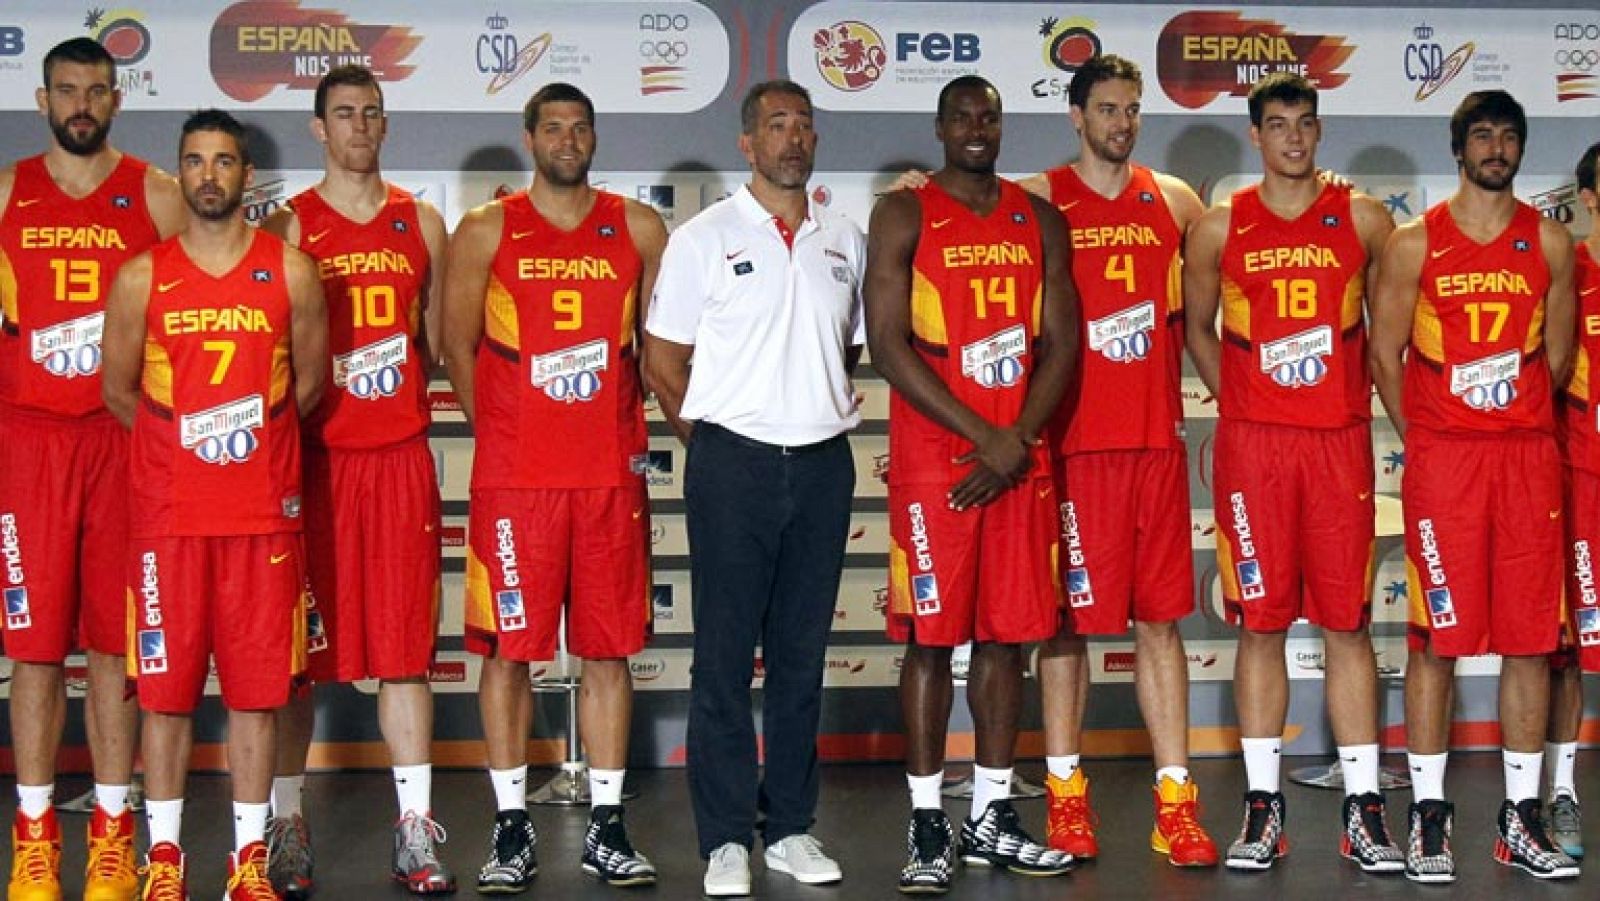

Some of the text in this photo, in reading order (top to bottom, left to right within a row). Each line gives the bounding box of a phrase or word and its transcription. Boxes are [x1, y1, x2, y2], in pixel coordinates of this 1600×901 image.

[237, 23, 361, 53] ESPAÑA
[639, 14, 689, 31] ADO
[295, 55, 330, 76] NOS
[476, 35, 518, 74] CSD
[1182, 33, 1297, 62] ESPAÑA
[1404, 44, 1443, 81] CSD
[1237, 64, 1270, 84] NOS
[22, 224, 126, 250] ESPAÑA
[943, 241, 1034, 268] ESPAÑA
[1070, 222, 1161, 249] ESPAÑA
[318, 248, 415, 280] ESPAÑA
[518, 256, 618, 281] ESPAÑA
[1104, 253, 1137, 293] 4
[1244, 244, 1341, 272] ESPAÑA
[50, 258, 100, 302] 13
[968, 276, 1017, 320] 14
[1272, 278, 1317, 318] 18
[1435, 269, 1532, 297] ESPAÑA
[163, 304, 273, 336] ESPAÑA
[349, 285, 396, 328] 10
[552, 289, 583, 330] 9
[1464, 302, 1511, 343] 17
[203, 340, 236, 385] 7
[215, 402, 259, 428] Miguel
[908, 502, 933, 571] endesa
[1060, 500, 1084, 566] endesa
[1231, 491, 1255, 558] endesa
[1, 512, 24, 585] endesa
[496, 518, 520, 587] endesa
[1418, 518, 1445, 585] endesa
[140, 550, 162, 627] endesa
[1575, 540, 1597, 605] endesa
